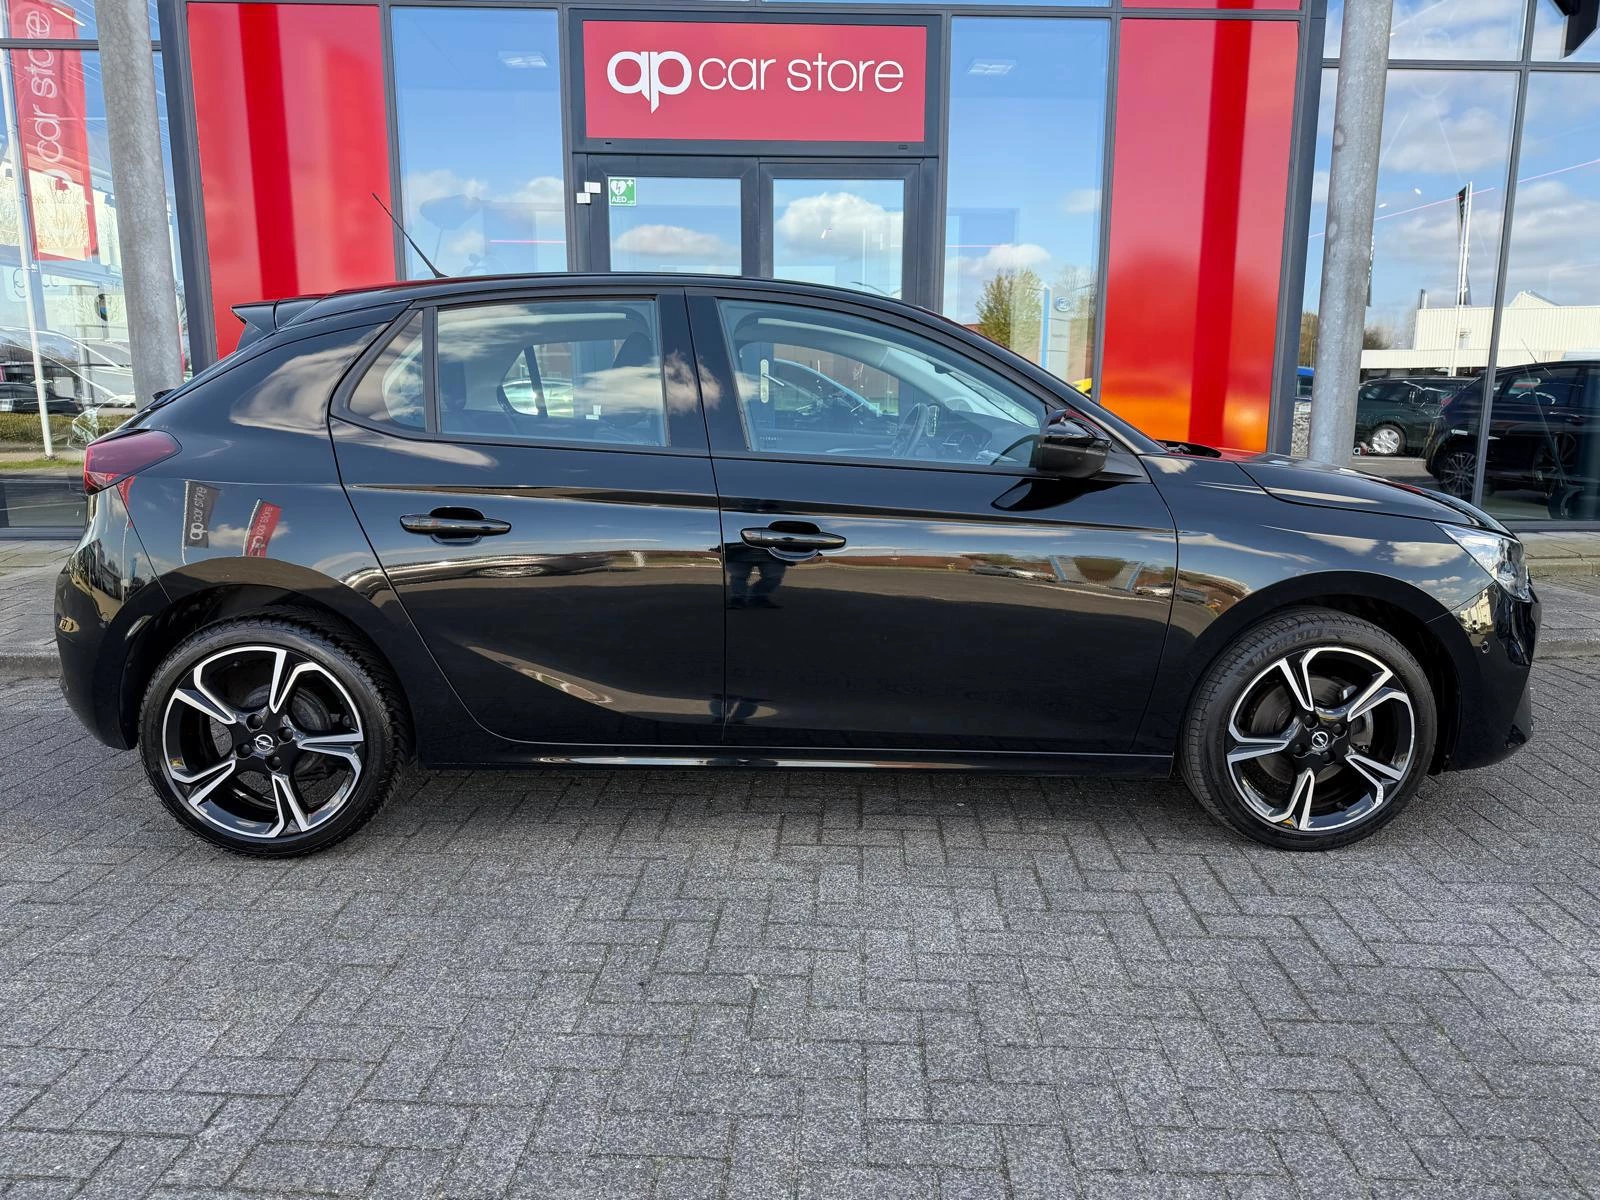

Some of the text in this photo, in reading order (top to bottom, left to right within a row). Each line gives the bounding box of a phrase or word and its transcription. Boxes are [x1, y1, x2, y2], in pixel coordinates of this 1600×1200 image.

[25, 10, 58, 99] stoe
[606, 50, 905, 114] ap car store
[33, 103, 64, 164] car
[611, 195, 628, 203] AED
[1252, 629, 1323, 664] MICHELIN
